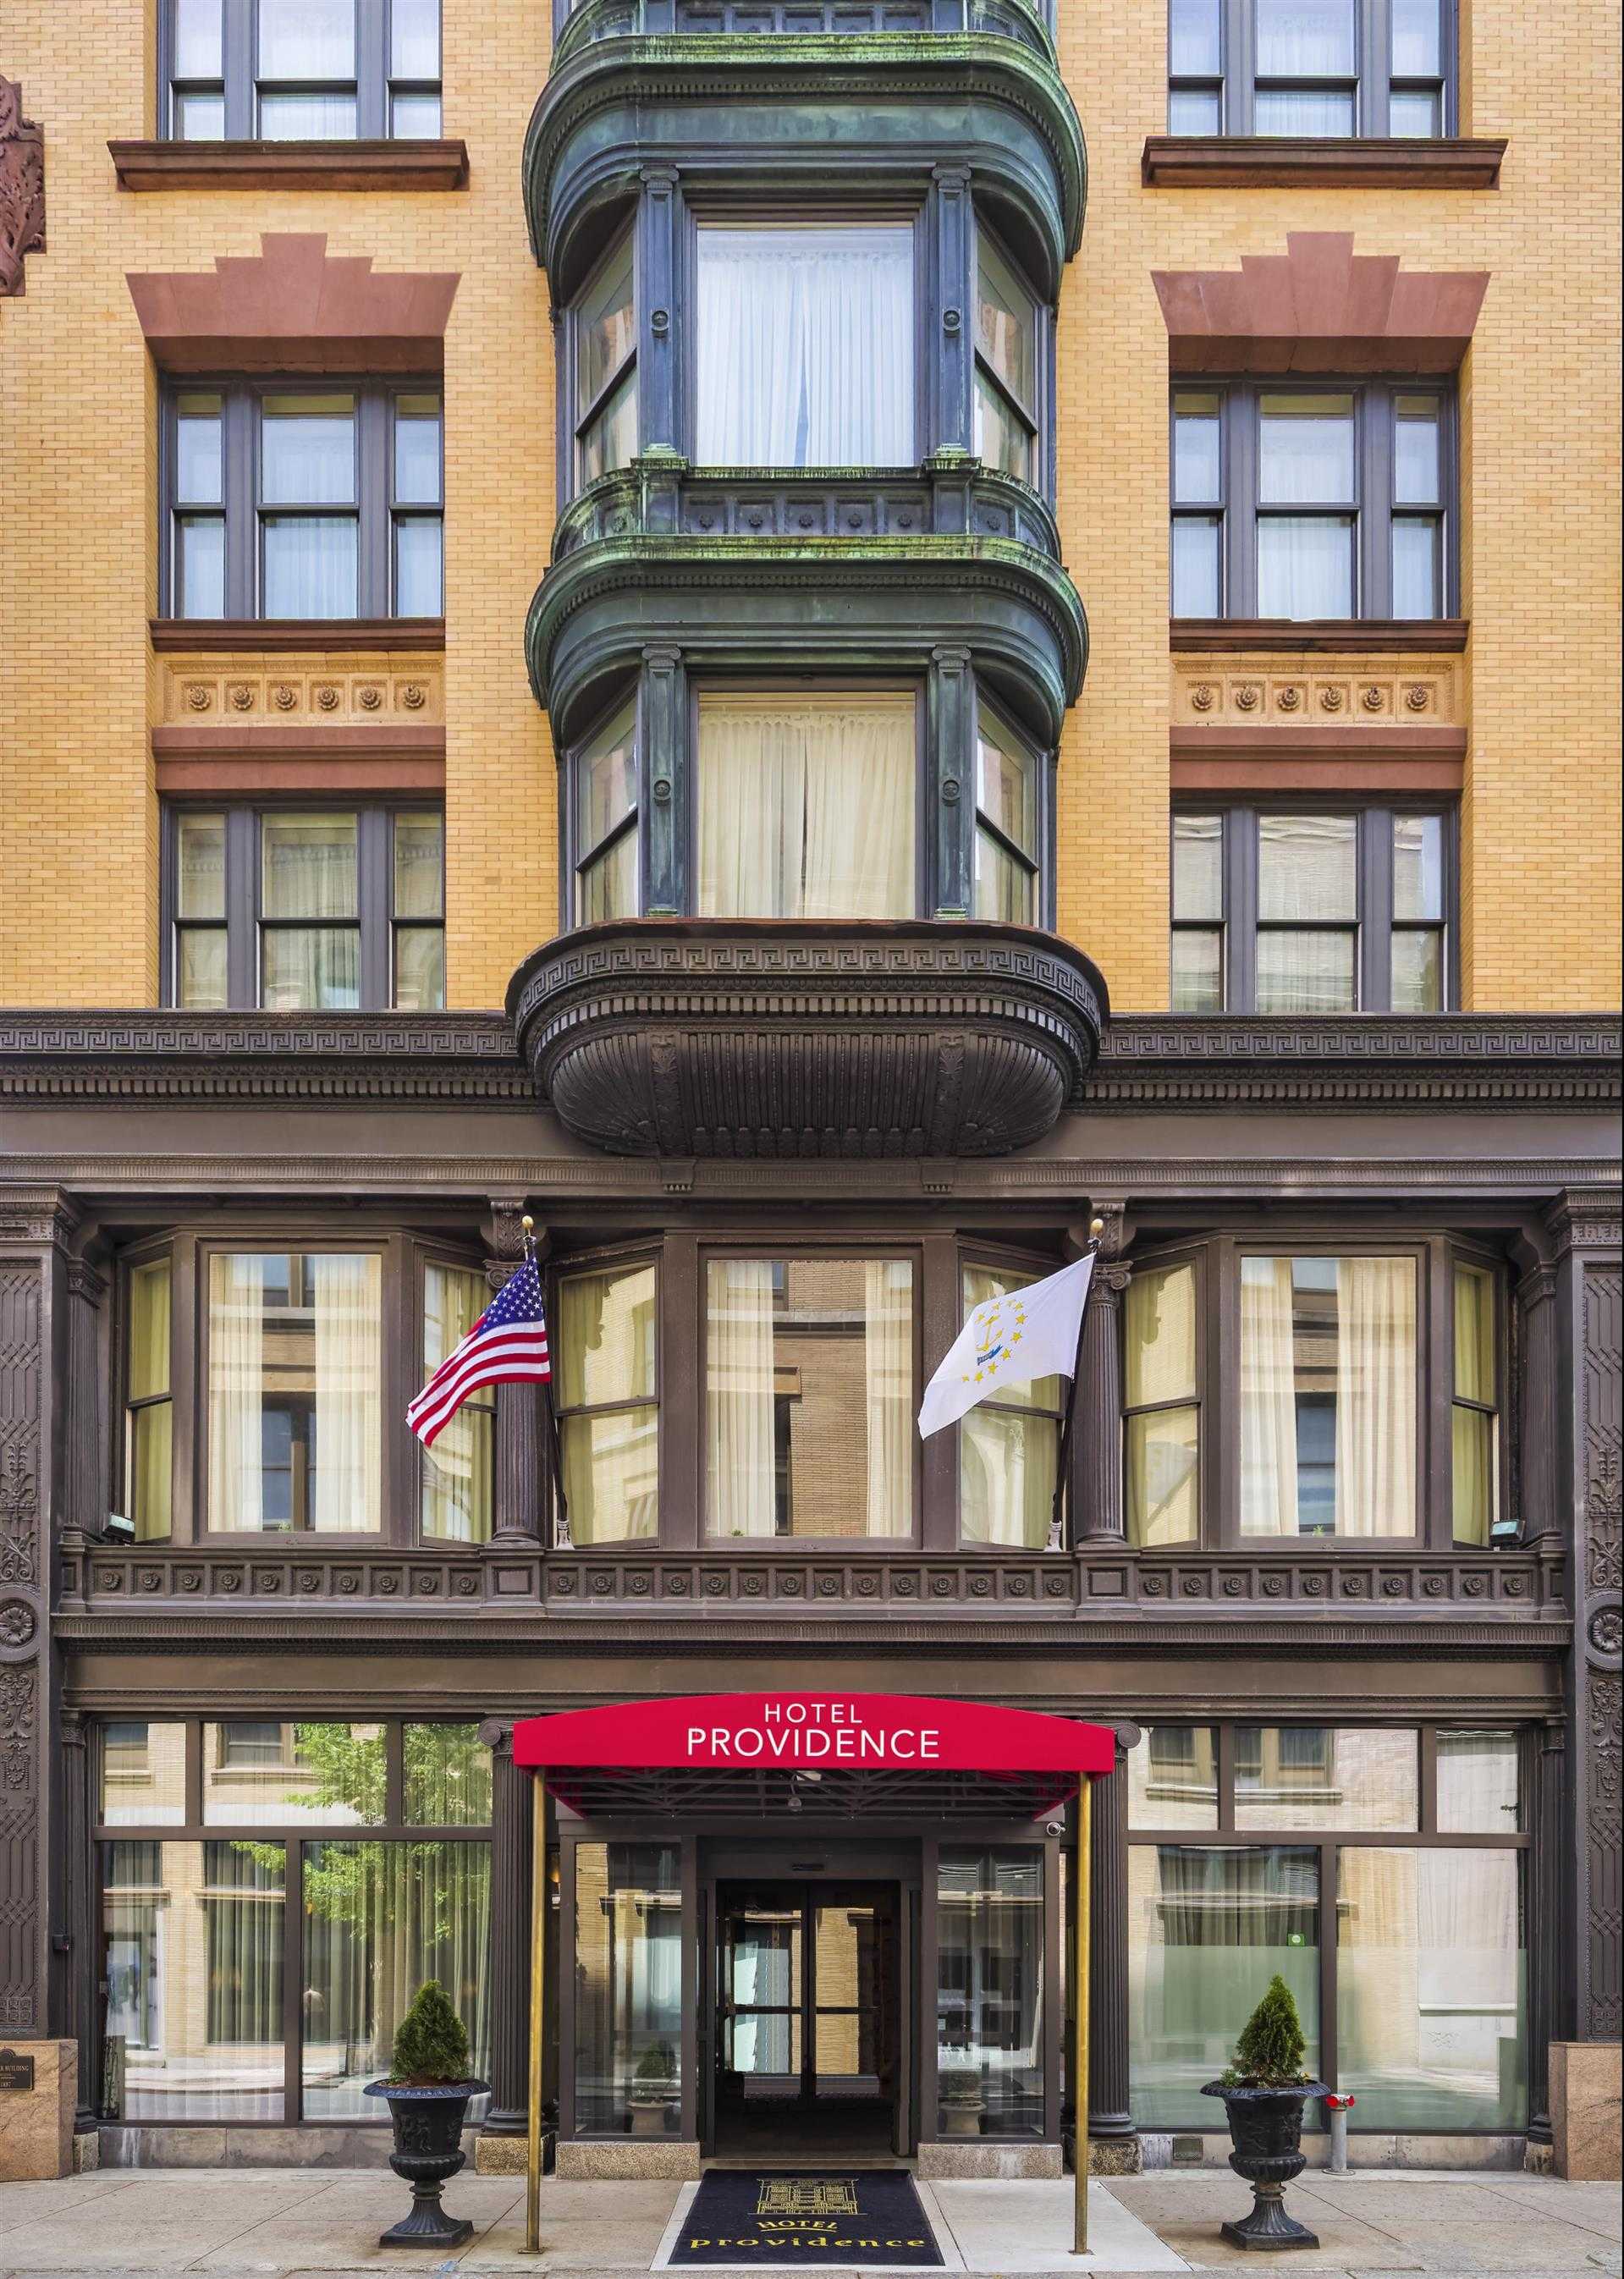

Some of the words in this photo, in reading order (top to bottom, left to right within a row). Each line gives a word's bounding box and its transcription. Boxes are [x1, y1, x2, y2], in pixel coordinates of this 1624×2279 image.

[764, 1704, 862, 1723] HOTEL
[687, 1727, 939, 1759] PROVIDENCE
[757, 2220, 839, 2229] HOTEL
[690, 2237, 925, 2249] providence
